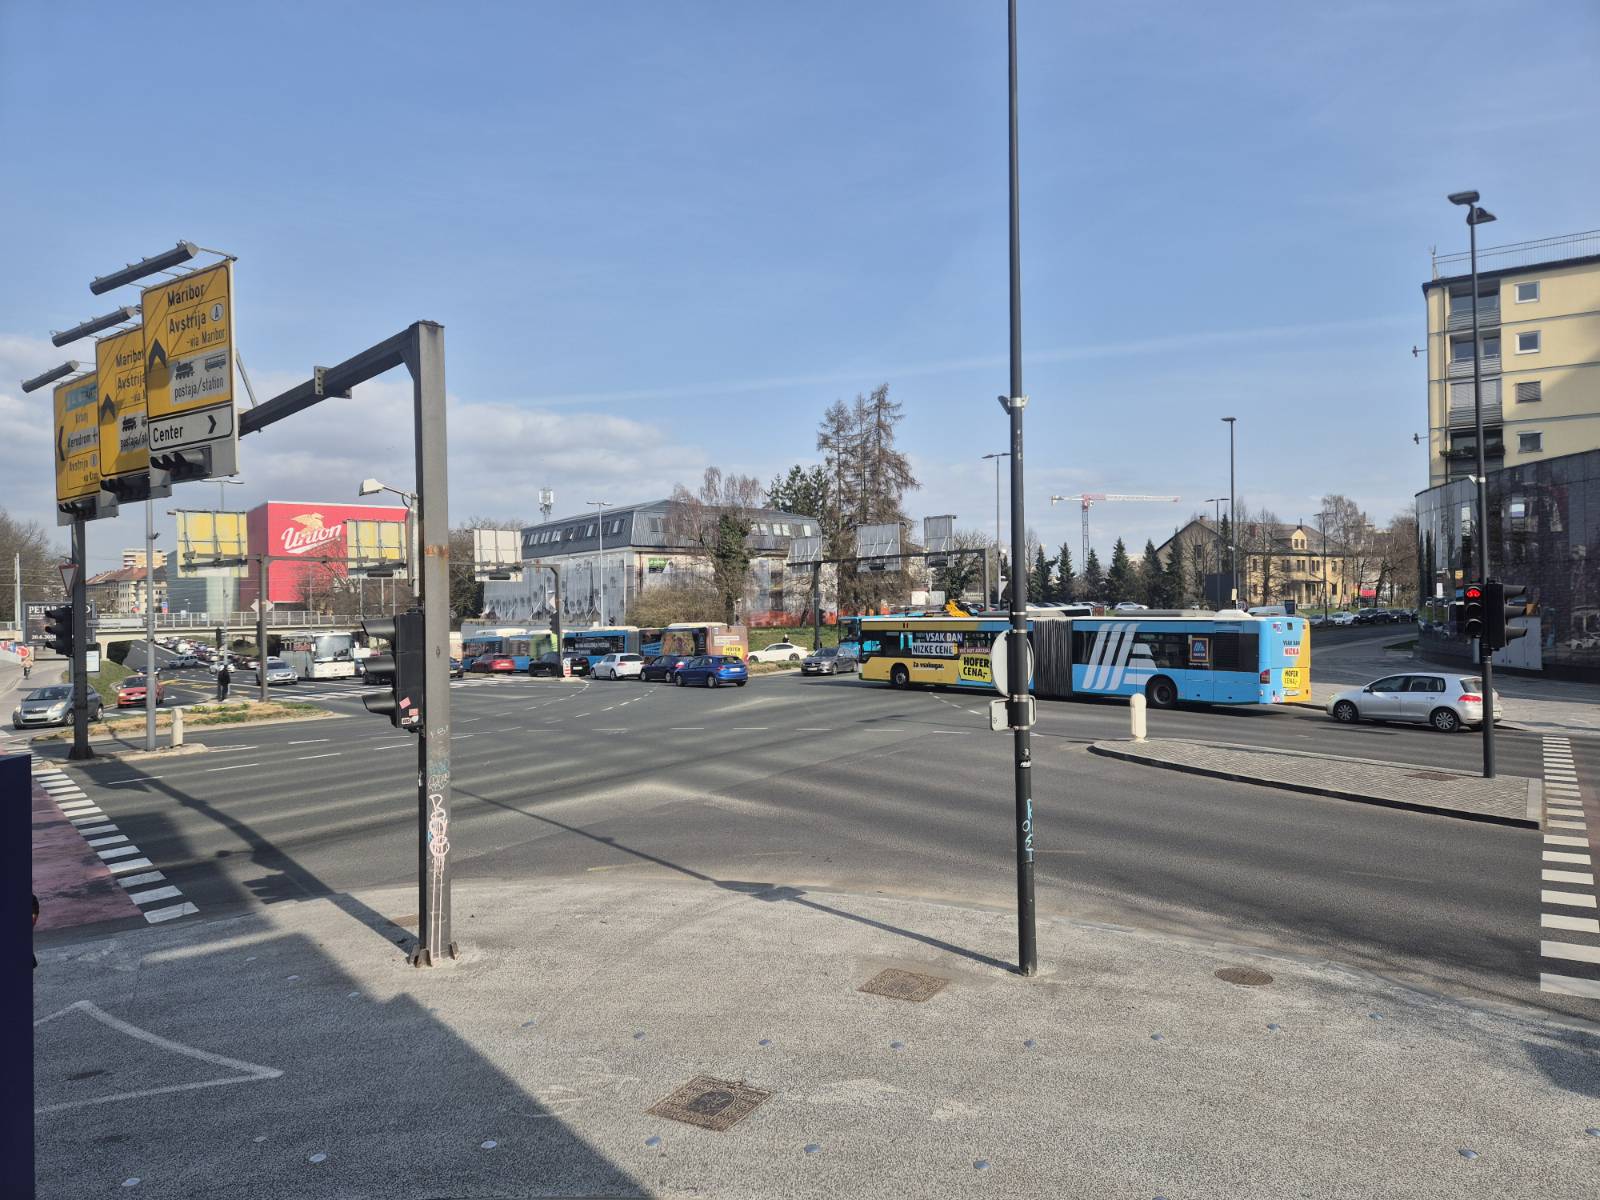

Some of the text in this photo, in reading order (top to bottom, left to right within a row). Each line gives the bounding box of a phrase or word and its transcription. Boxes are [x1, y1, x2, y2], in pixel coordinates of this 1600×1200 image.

[167, 283, 205, 307] Maribor
[168, 310, 206, 334] Avstrija
[201, 328, 225, 345] Maribor
[174, 377, 224, 401] postaja/station
[153, 425, 184, 442] Center
[281, 525, 342, 550] Union
[925, 632, 963, 643] VSAK DAN
[913, 645, 954, 655] NIZKE CENE
[963, 657, 989, 668] HOFER
